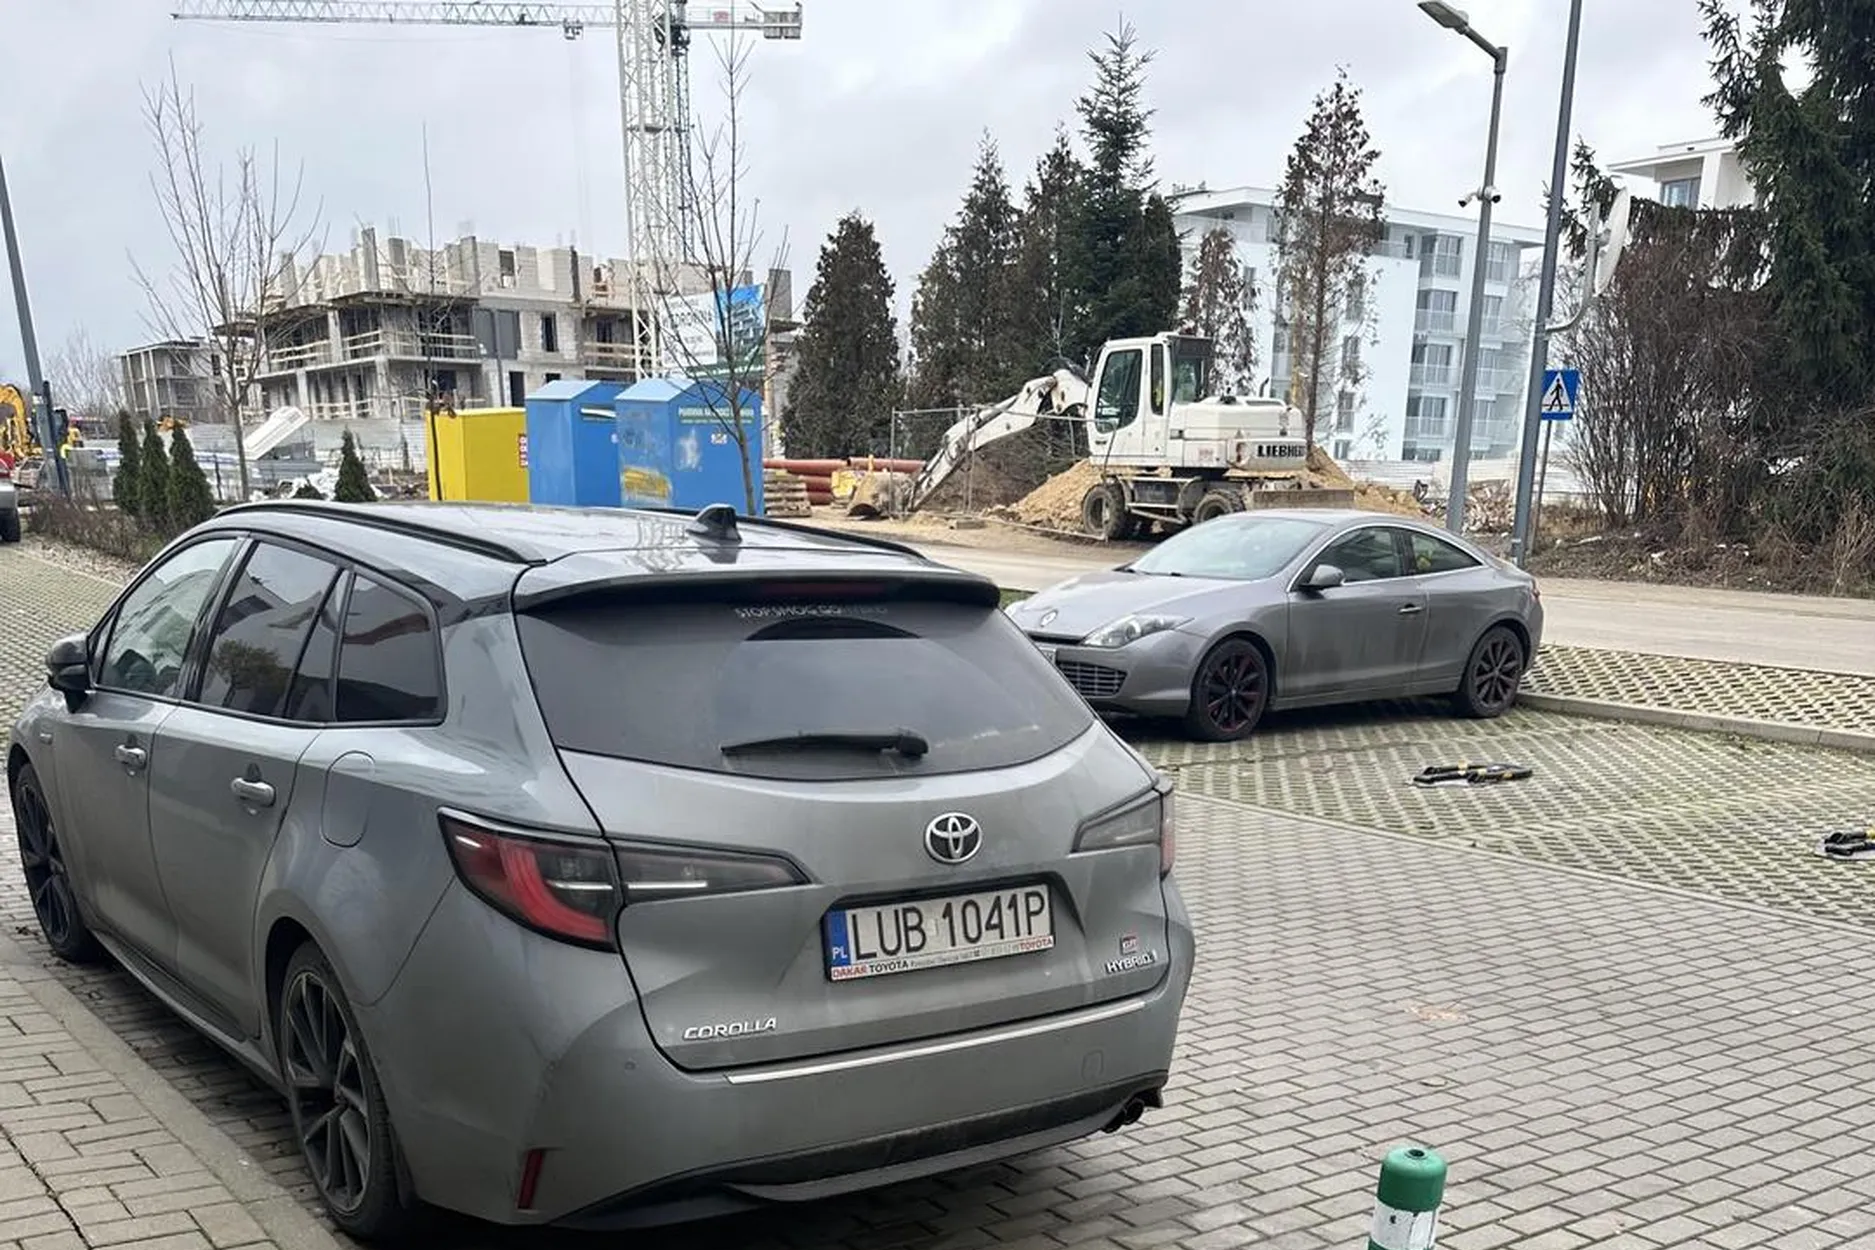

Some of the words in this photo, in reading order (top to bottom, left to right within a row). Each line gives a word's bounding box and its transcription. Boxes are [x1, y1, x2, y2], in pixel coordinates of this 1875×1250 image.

[852, 906, 927, 960] LUB
[942, 891, 1046, 947] 1041P
[832, 947, 848, 960] PL
[1020, 938, 1053, 951] TOYOTA
[832, 964, 868, 978] DAKAR
[869, 960, 909, 973] TOYOTA
[1106, 952, 1153, 974] HYBRID
[683, 1017, 777, 1040] COROLLA
